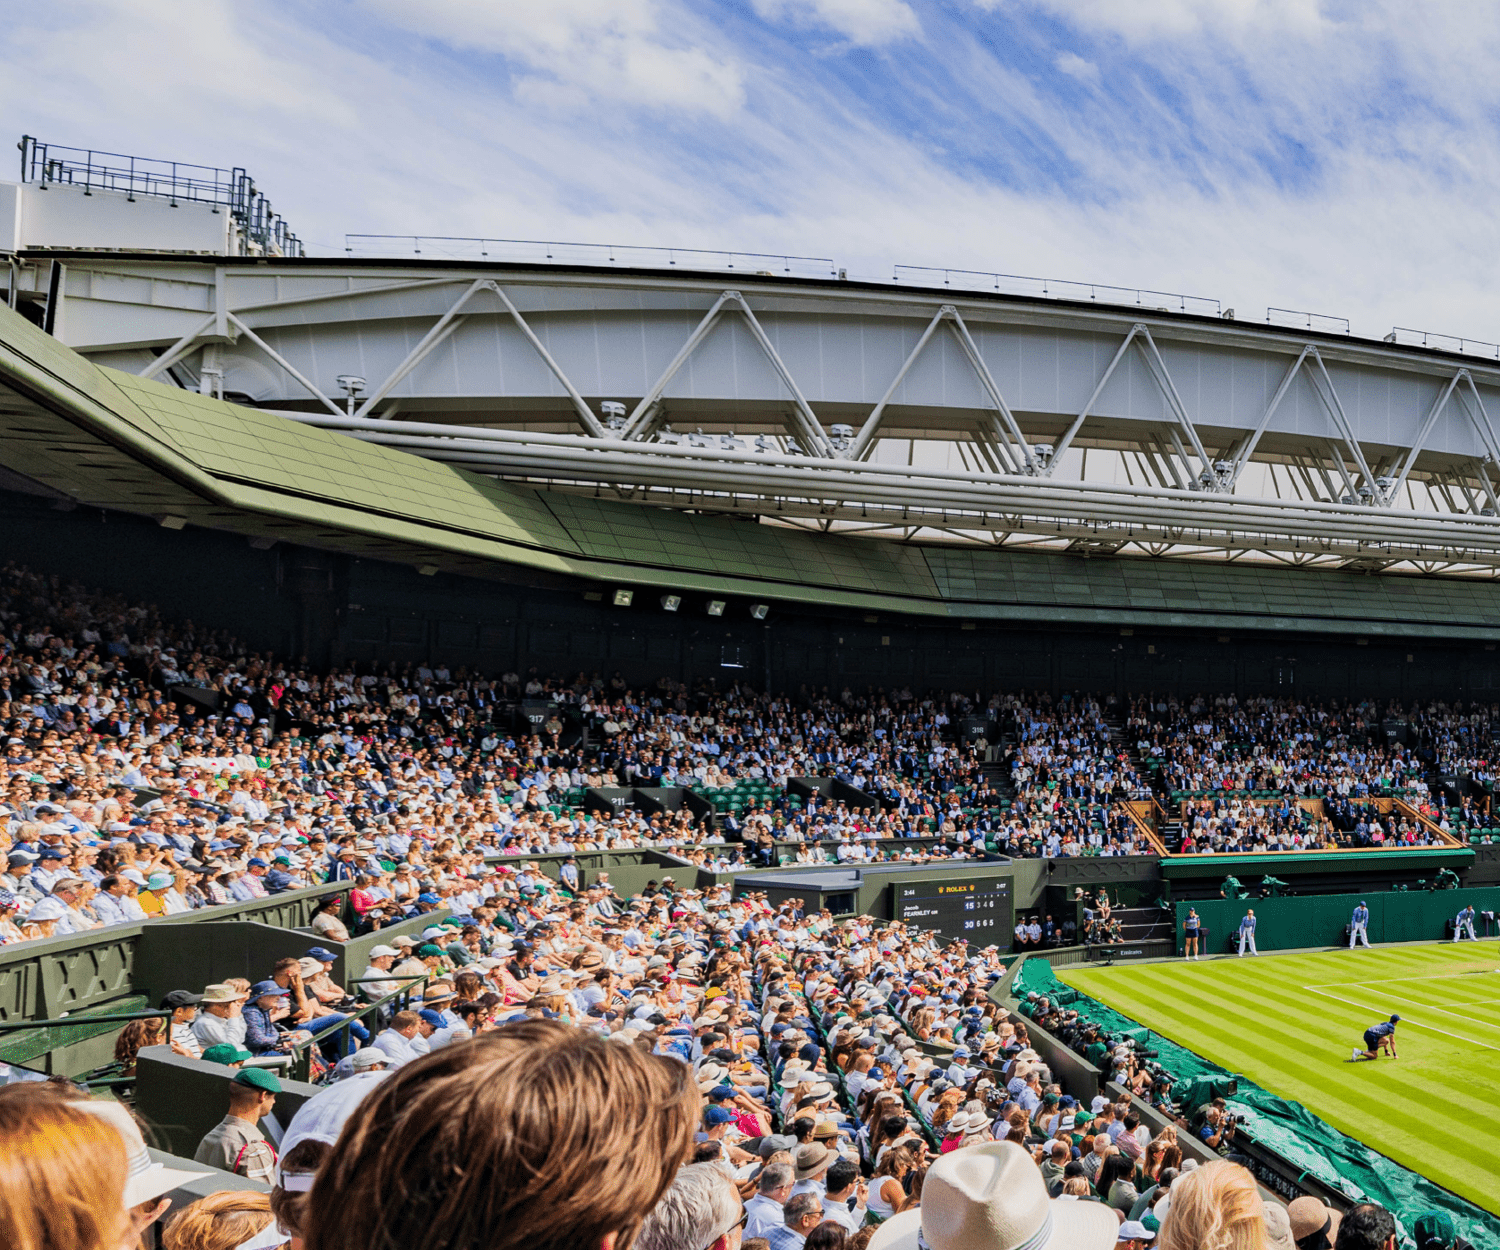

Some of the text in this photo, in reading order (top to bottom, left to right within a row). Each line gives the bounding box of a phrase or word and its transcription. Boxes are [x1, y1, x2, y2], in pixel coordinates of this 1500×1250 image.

[529, 715, 544, 723] 317
[965, 902, 974, 910] 15
[965, 921, 974, 929] 30
